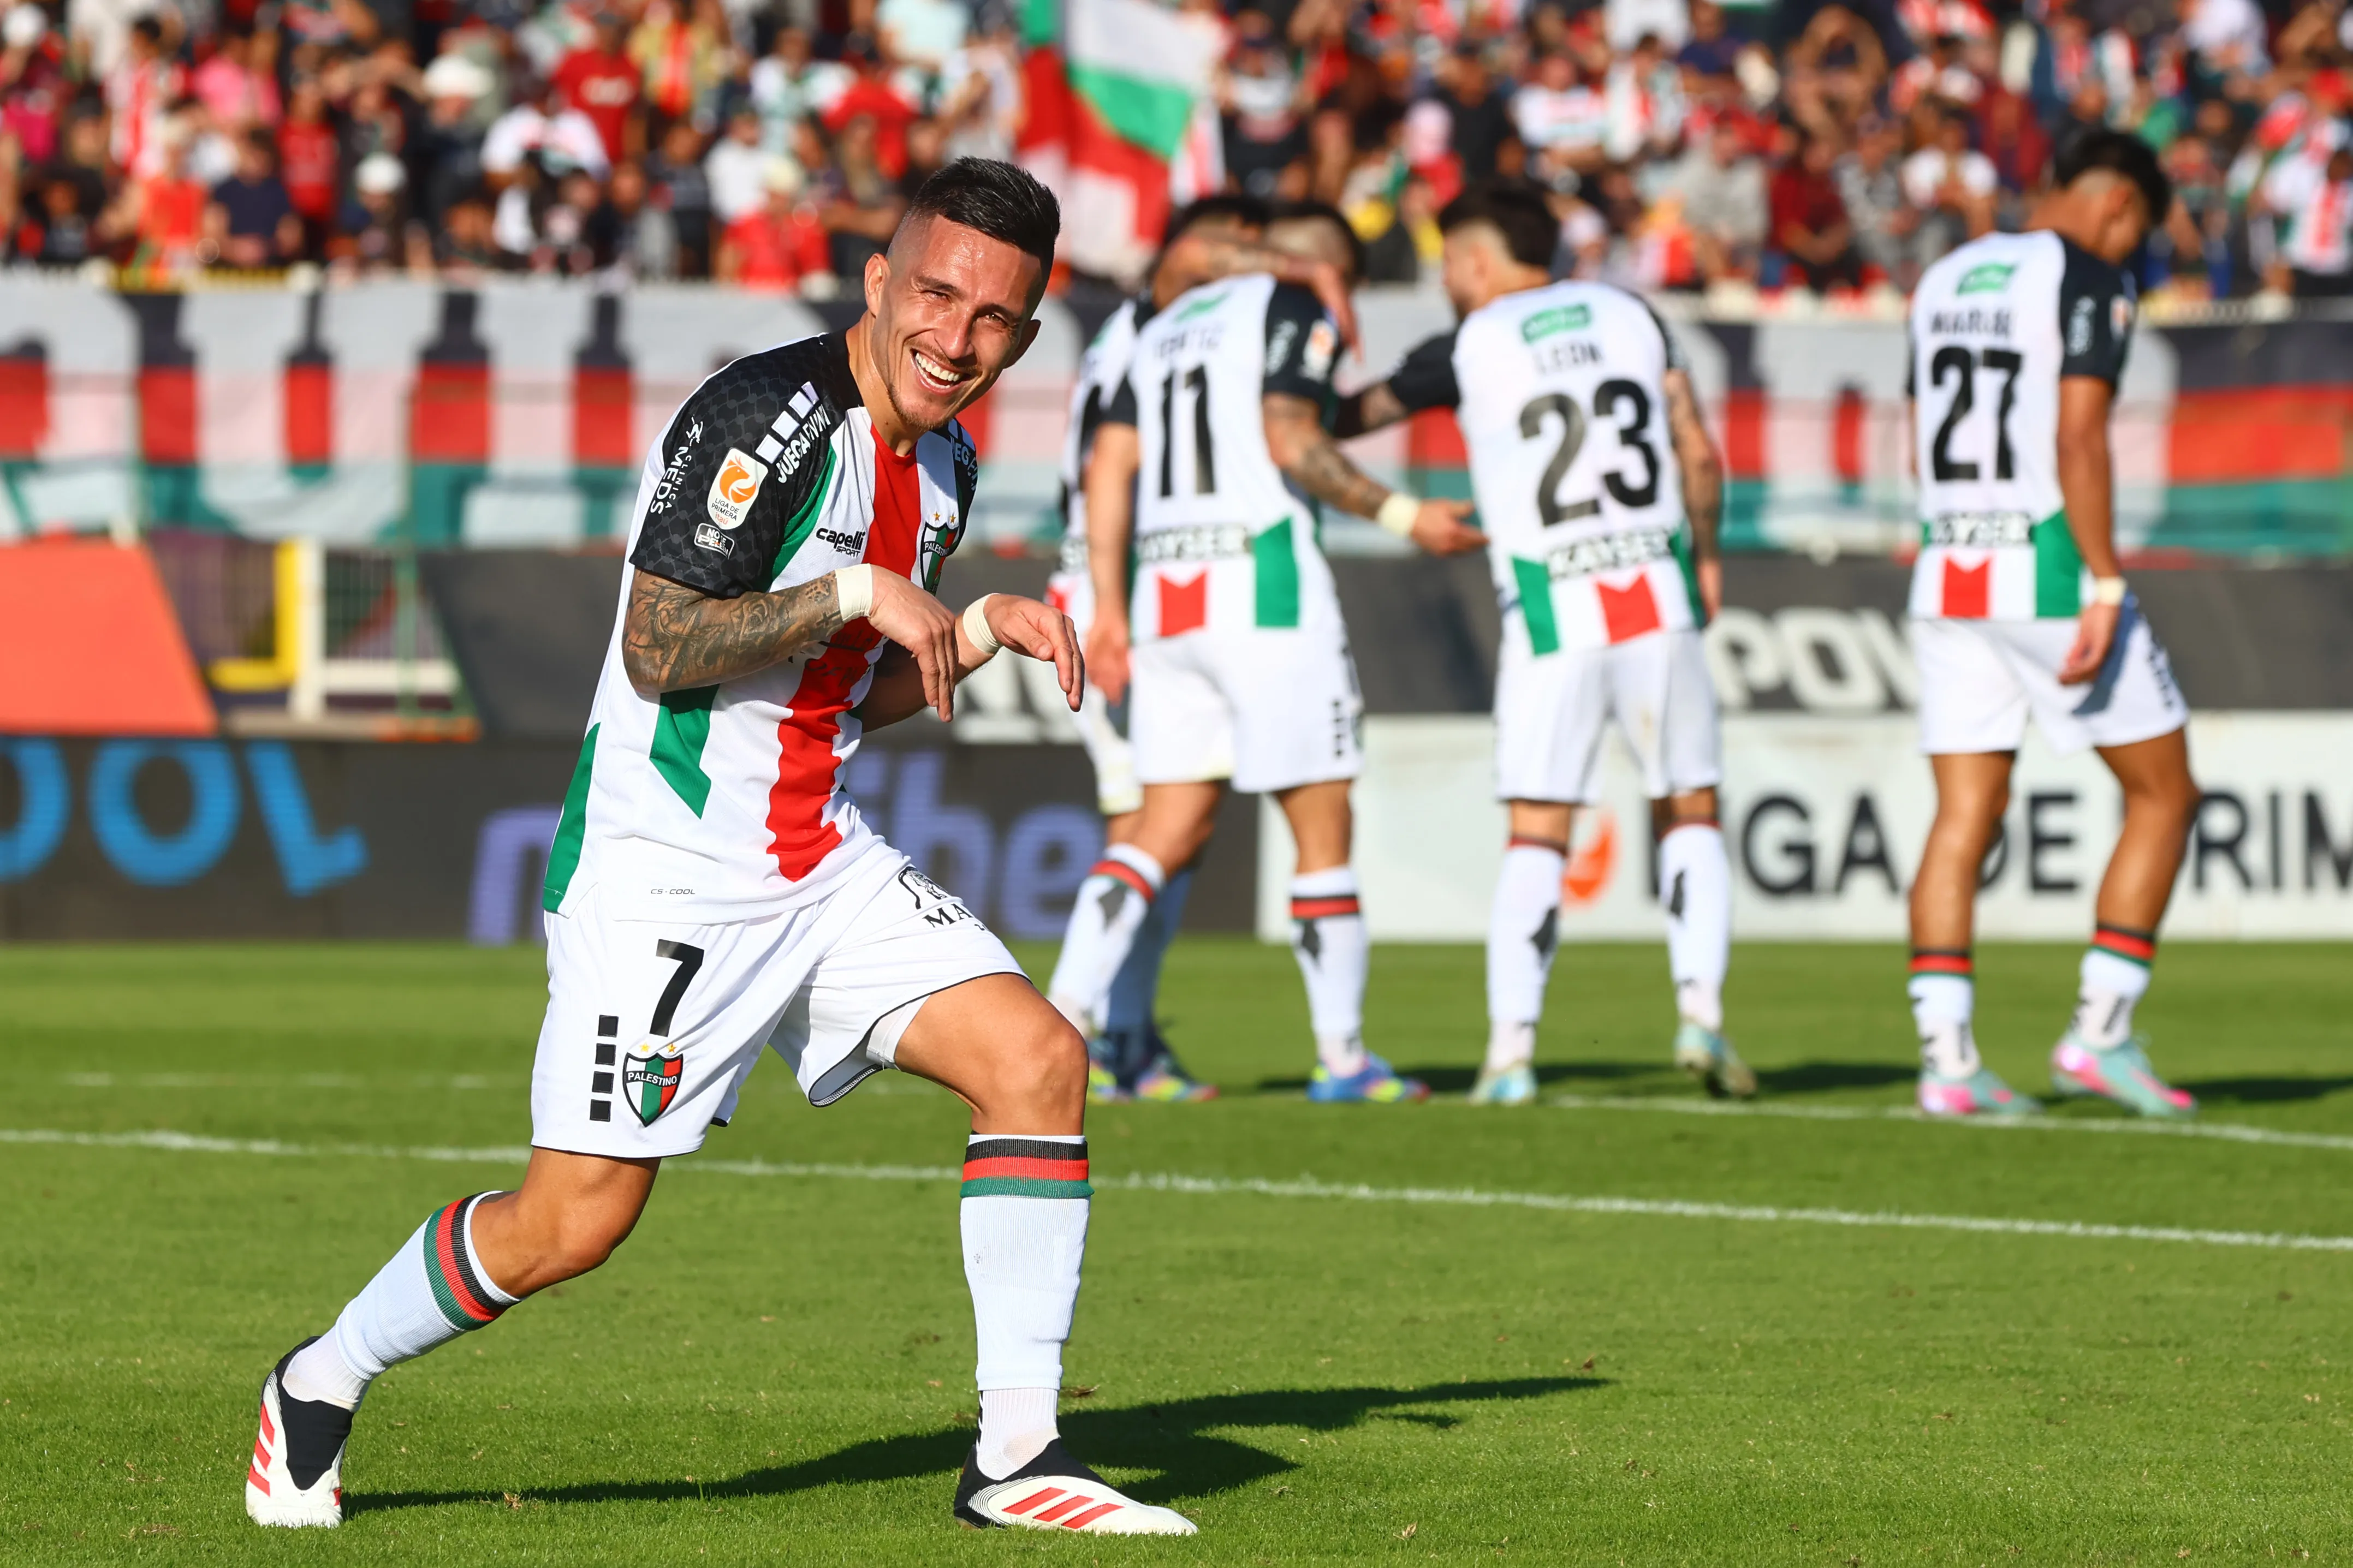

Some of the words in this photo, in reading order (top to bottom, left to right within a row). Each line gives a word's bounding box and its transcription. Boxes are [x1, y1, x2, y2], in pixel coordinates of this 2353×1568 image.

[1930, 345, 2024, 481] 27
[1159, 362, 1216, 498] 11
[1518, 379, 1660, 528] 23
[650, 446, 688, 514] MEDS
[711, 503, 737, 521] PRIMERA
[715, 497, 729, 509] LIGA
[730, 505, 739, 514] DE
[715, 511, 729, 525] itaú
[706, 528, 720, 539] NO
[816, 528, 866, 551] capelli
[835, 546, 860, 557] SPORT
[650, 939, 705, 1037] 7
[628, 1072, 677, 1086] PALESTINO
